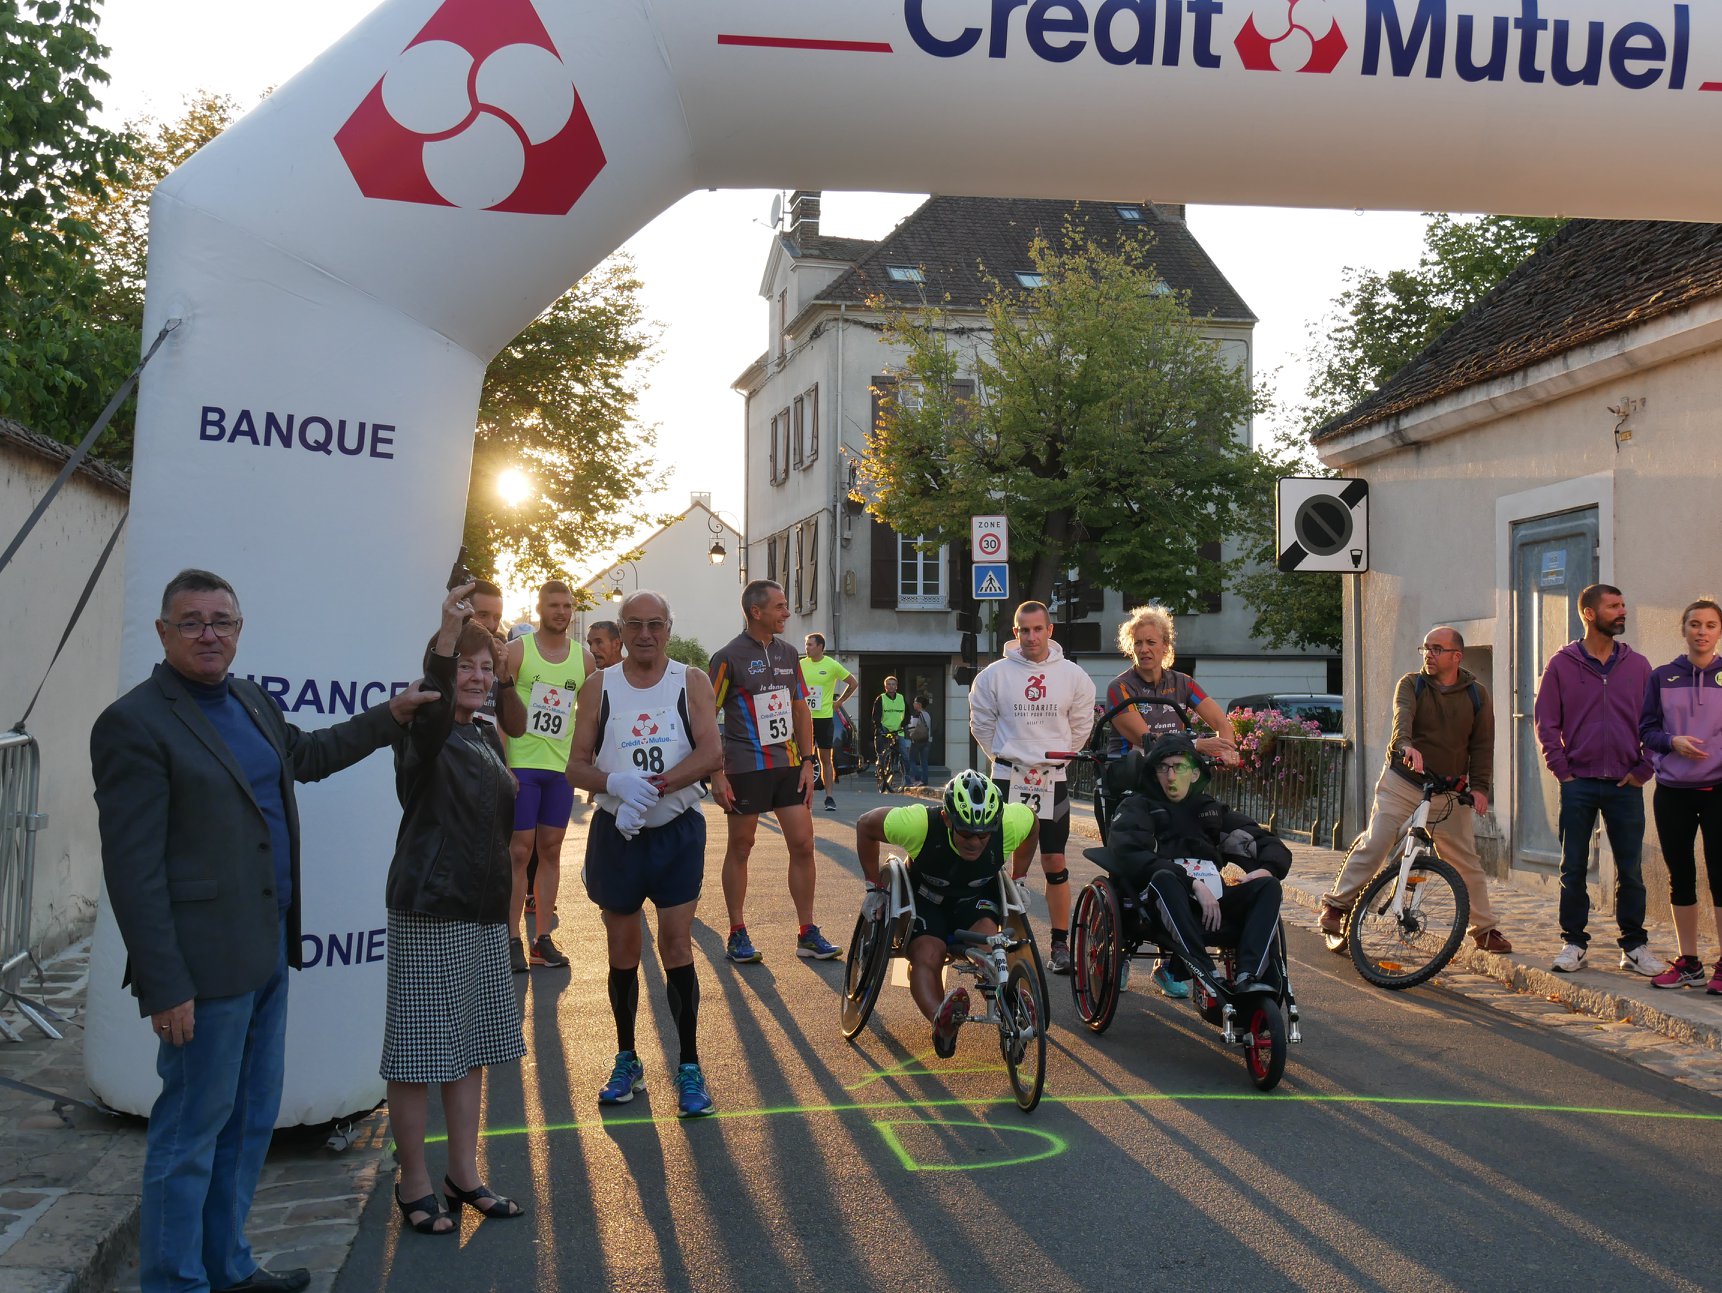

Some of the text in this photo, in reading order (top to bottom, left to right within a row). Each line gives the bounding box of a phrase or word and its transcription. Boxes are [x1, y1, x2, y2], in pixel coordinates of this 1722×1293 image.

[1361, 0, 1690, 90] Mutuel
[200, 406, 396, 459] BANQUE
[983, 539, 997, 549] 30
[533, 710, 562, 734] 139
[769, 718, 788, 739] 53
[632, 746, 665, 774] 98
[1020, 793, 1041, 814] 73
